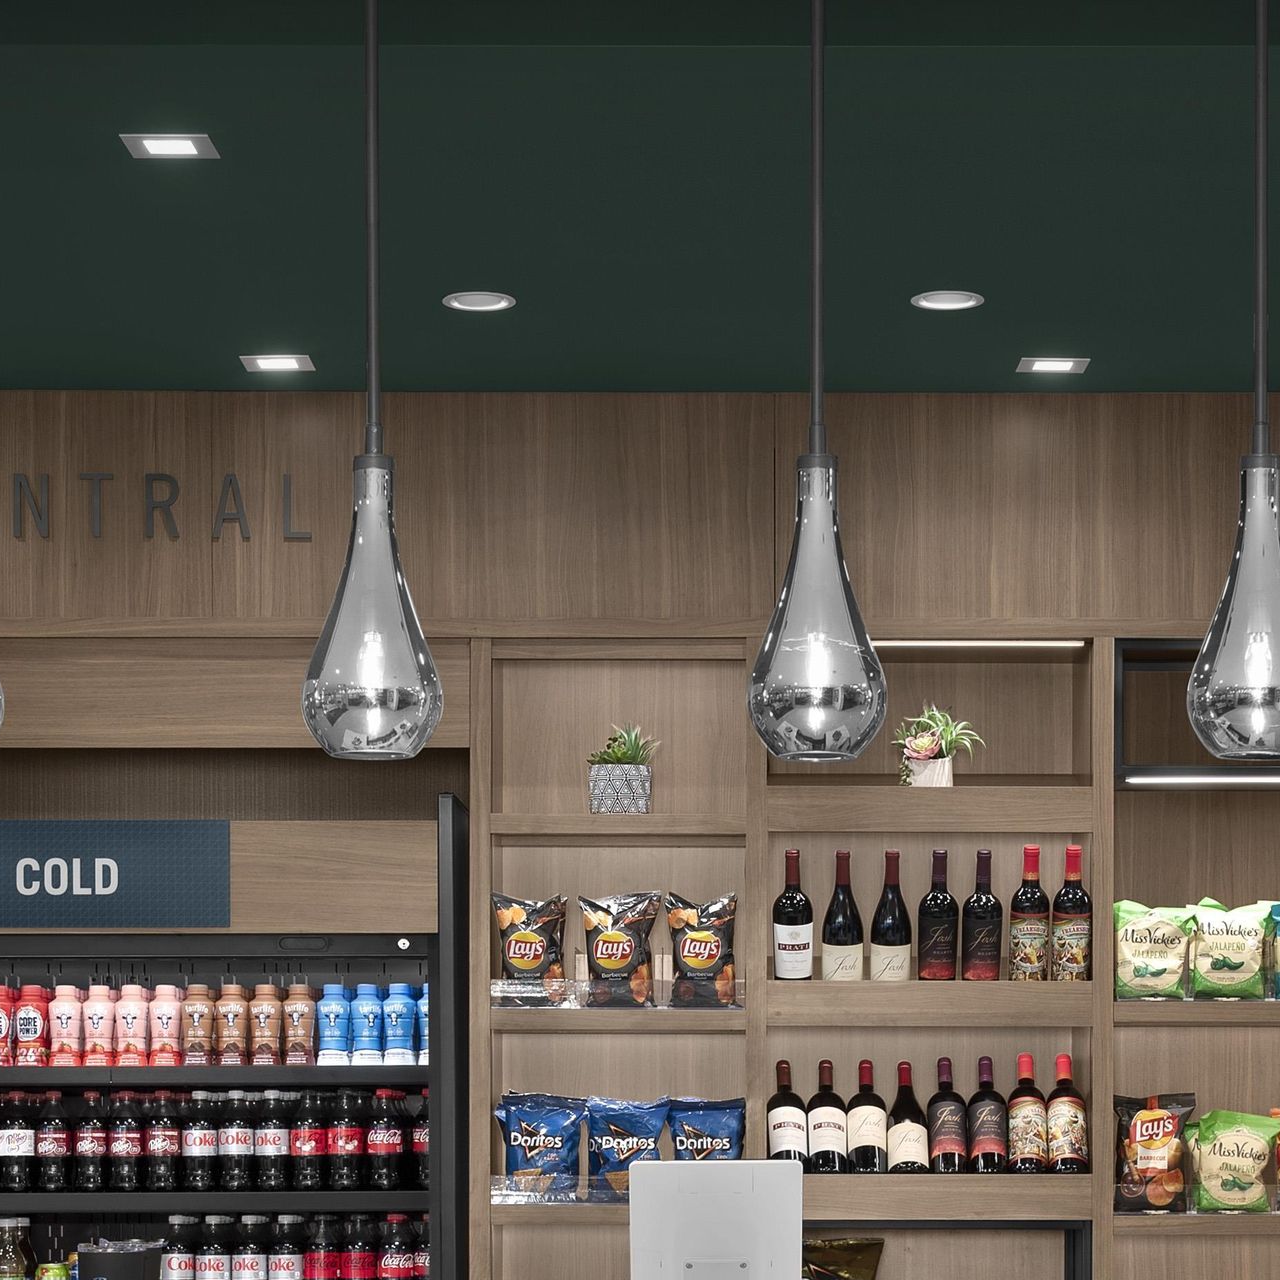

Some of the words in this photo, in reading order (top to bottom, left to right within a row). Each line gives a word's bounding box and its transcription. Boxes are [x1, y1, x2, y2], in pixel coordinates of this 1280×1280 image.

[16, 858, 120, 897] COLD
[1120, 929, 1148, 944] Miss
[1147, 926, 1182, 948] Vickie's
[1224, 921, 1259, 939] Vickie's
[509, 939, 544, 960] Lay's
[596, 938, 632, 960] Lay's
[683, 938, 719, 960] Lay's
[1210, 942, 1246, 952] JALAPEÑO
[19, 1017, 38, 1026] CORE
[19, 1027, 38, 1035] POWER
[218, 1131, 251, 1145] Coke
[1135, 1116, 1174, 1142] Lay's
[185, 1132, 217, 1147] Coke
[511, 1132, 562, 1150] Doritos
[602, 1135, 655, 1153] Doritos
[676, 1135, 730, 1151] Doritos
[1210, 1142, 1236, 1157] Miss
[1235, 1142, 1267, 1163] Vickie's
